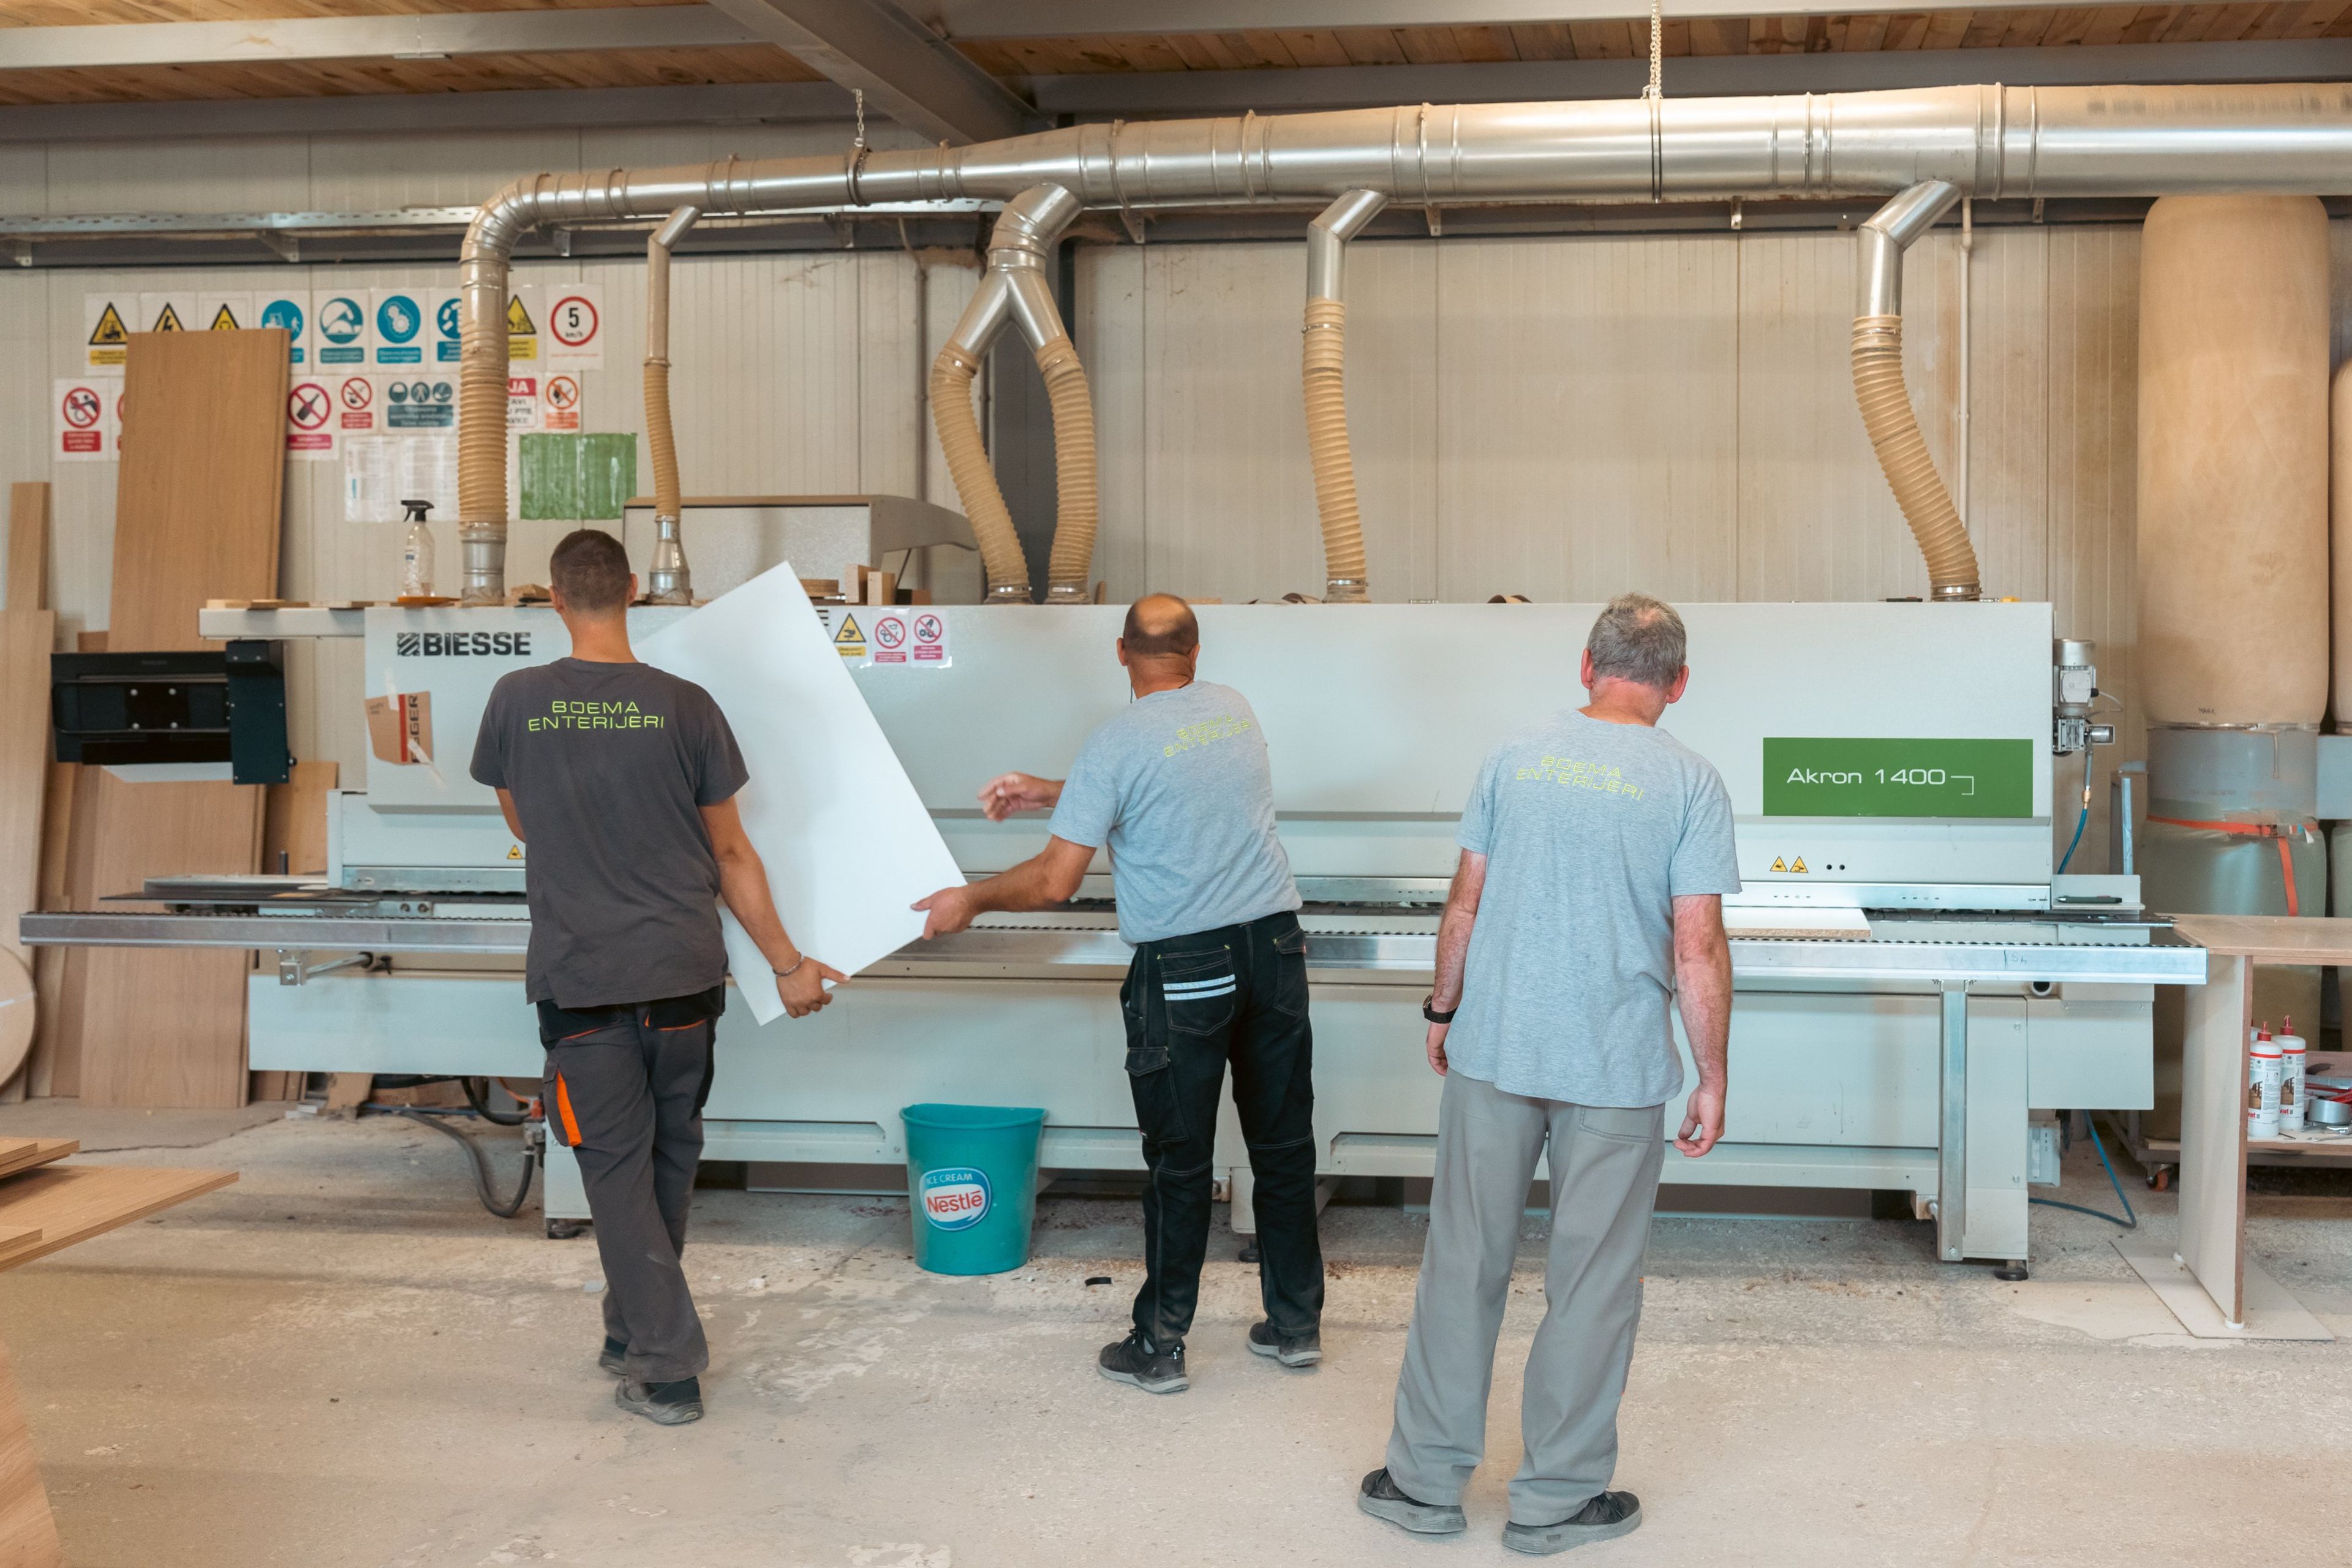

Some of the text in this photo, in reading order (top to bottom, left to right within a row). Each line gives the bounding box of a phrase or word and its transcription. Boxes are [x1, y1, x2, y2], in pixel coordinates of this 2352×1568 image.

[568, 307, 579, 328] 5
[507, 380, 530, 393] JA
[423, 631, 532, 657] BIESSE
[552, 701, 640, 715] BOEMA
[528, 715, 665, 732] ENTERIJERI
[1176, 714, 1235, 740] BOEMA
[1540, 755, 1623, 780] BOEMA
[1786, 767, 1947, 786] Akron 1400
[1516, 767, 1645, 801] ENTERIJERI
[927, 1173, 973, 1184] ICE CREAM
